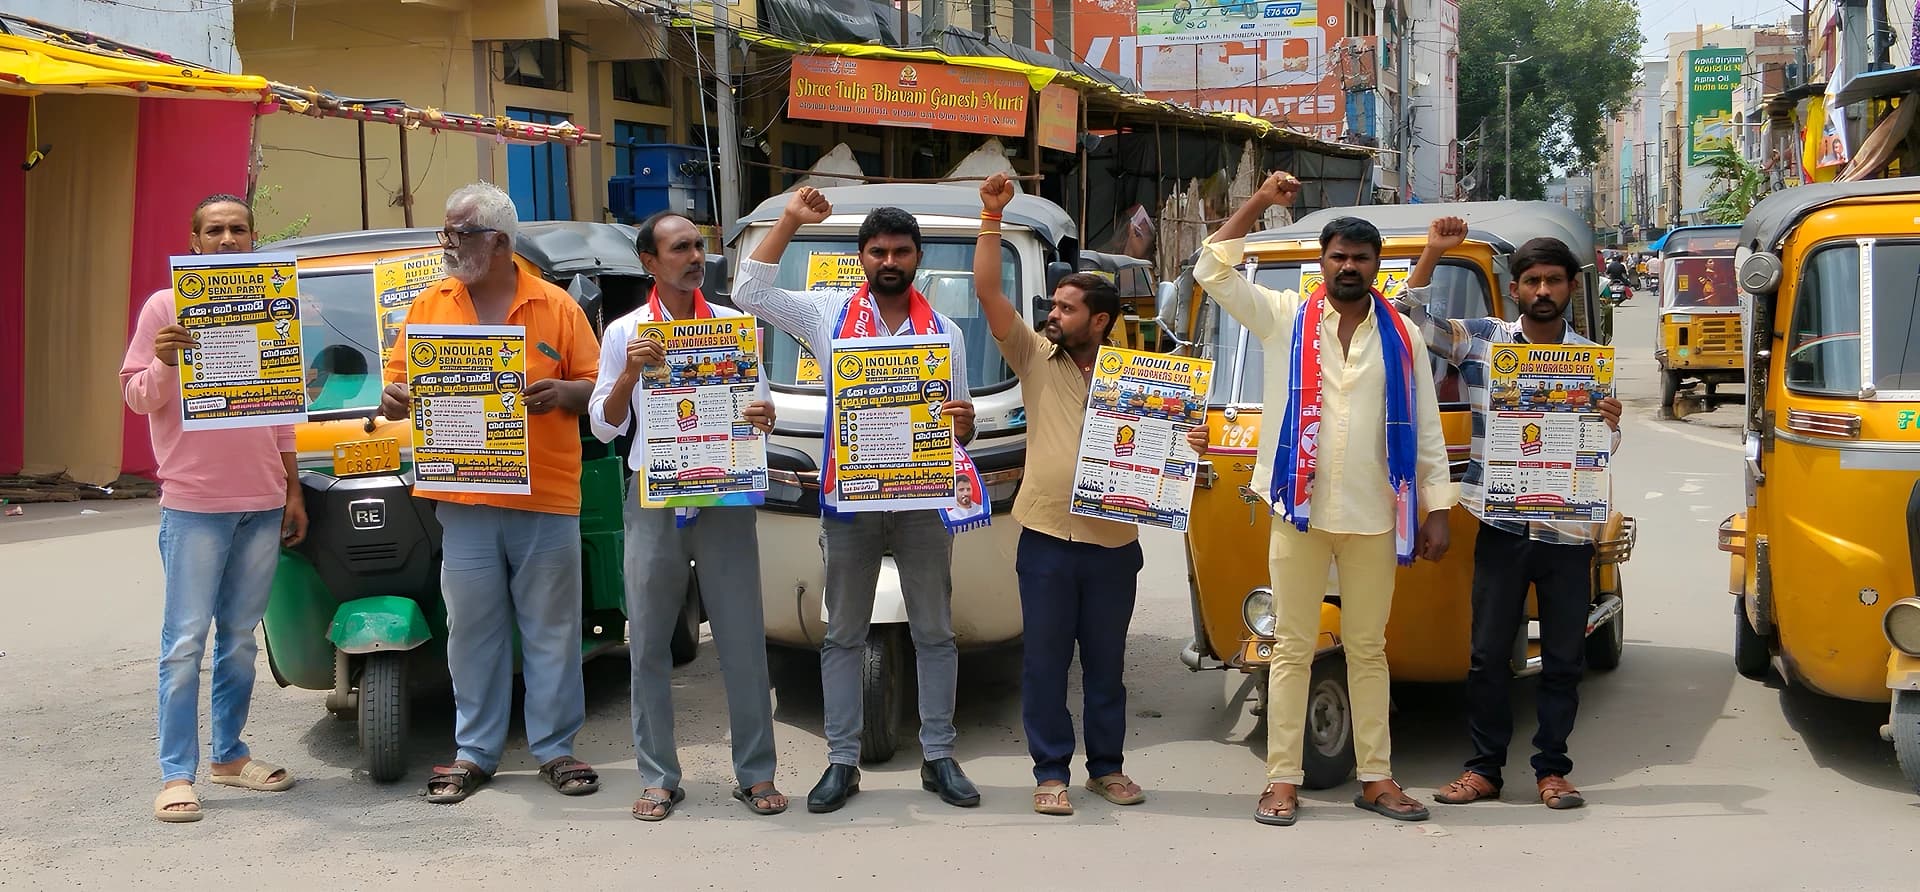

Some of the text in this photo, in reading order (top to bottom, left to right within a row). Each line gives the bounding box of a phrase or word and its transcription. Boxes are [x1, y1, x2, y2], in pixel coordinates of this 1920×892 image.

[795, 77, 1024, 111] Shree Tulja Bhavani Ganesh Murti
[208, 285, 266, 295] SENA PARTY
[438, 357, 494, 365] SENA PARTY
[864, 366, 920, 376] SENA PARTY
[1536, 364, 1574, 373] WORKERS
[356, 510, 380, 522] RE
